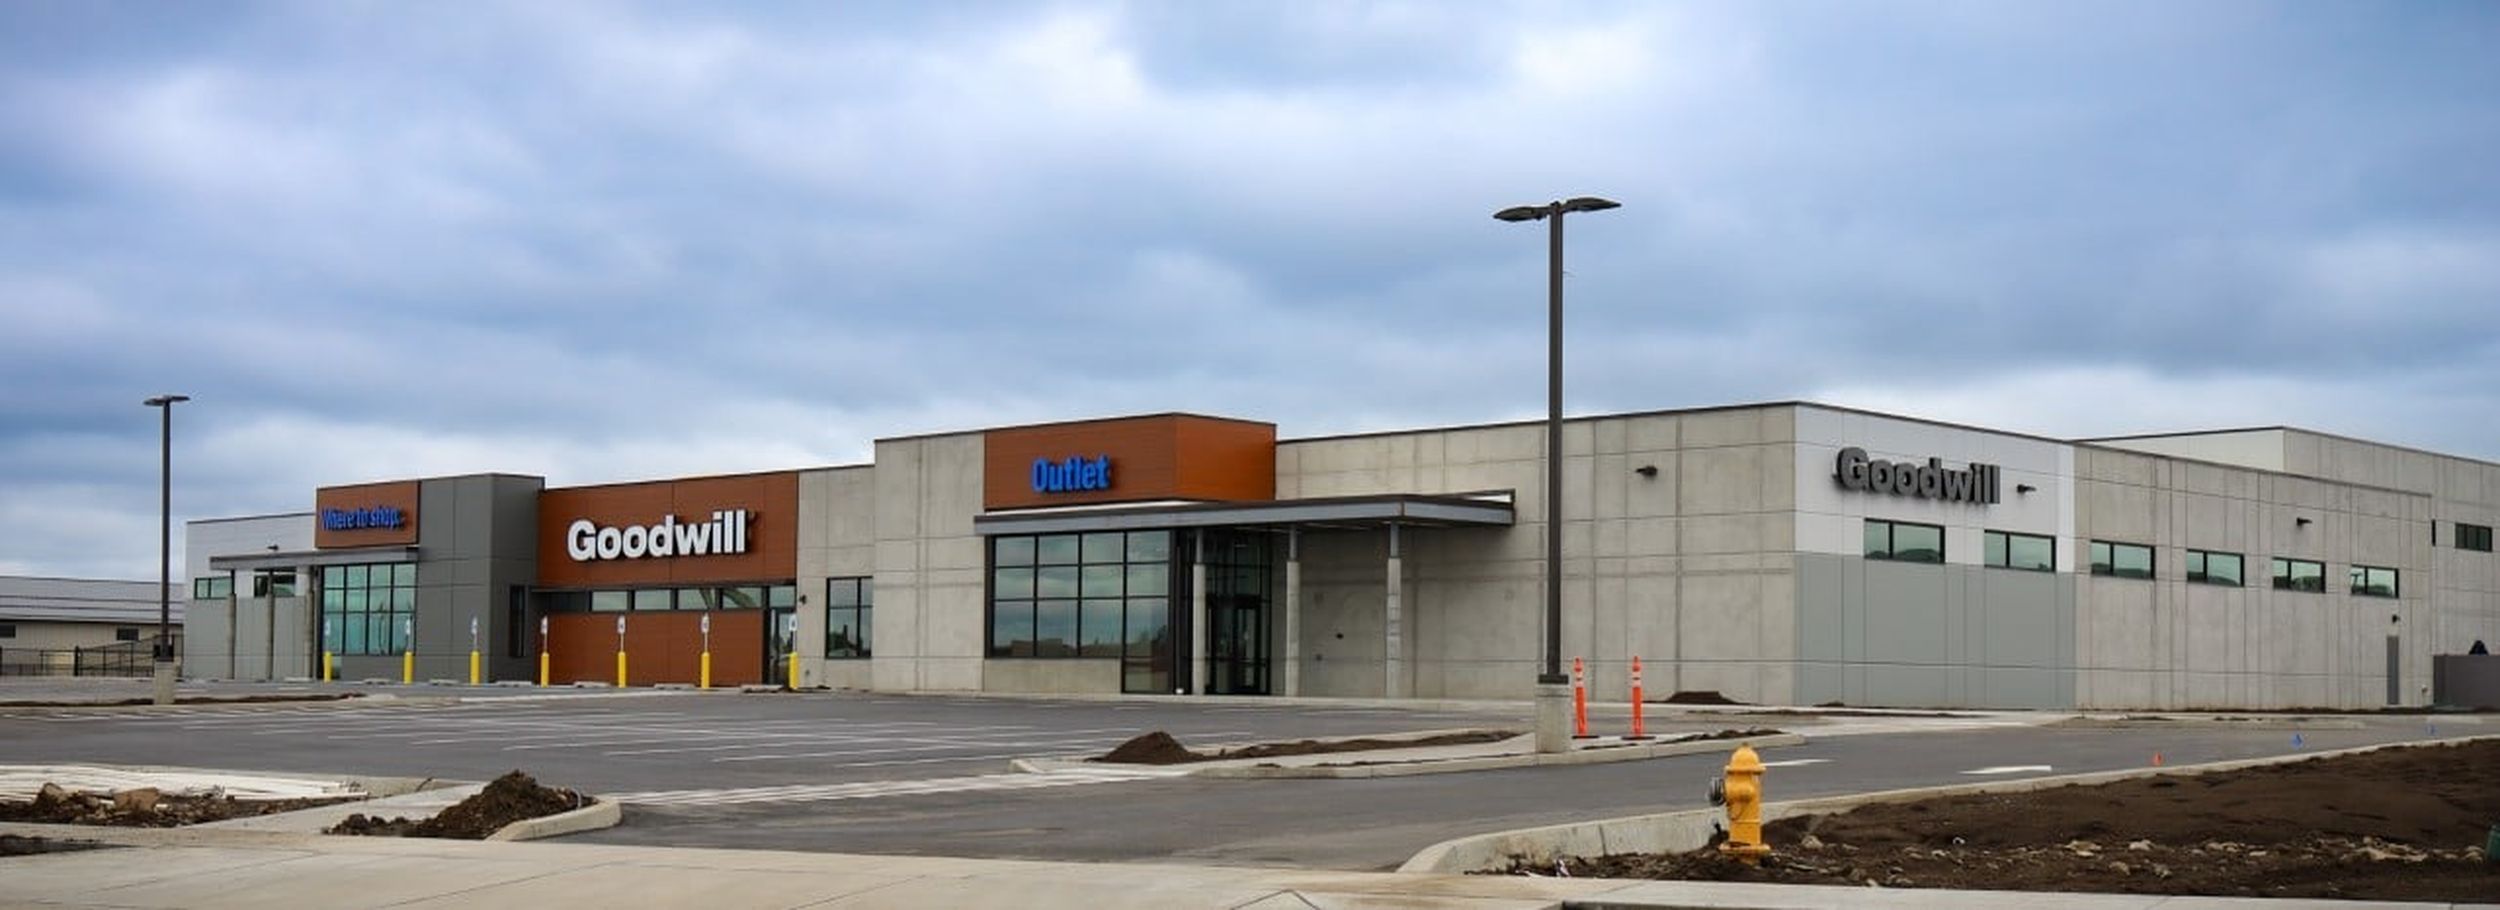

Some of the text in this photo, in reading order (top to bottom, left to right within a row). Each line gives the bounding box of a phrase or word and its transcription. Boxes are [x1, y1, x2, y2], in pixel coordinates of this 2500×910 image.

[1032, 454, 1111, 492] Outlet
[1836, 447, 2001, 504] Goodwill
[567, 509, 746, 561] Goodwill
